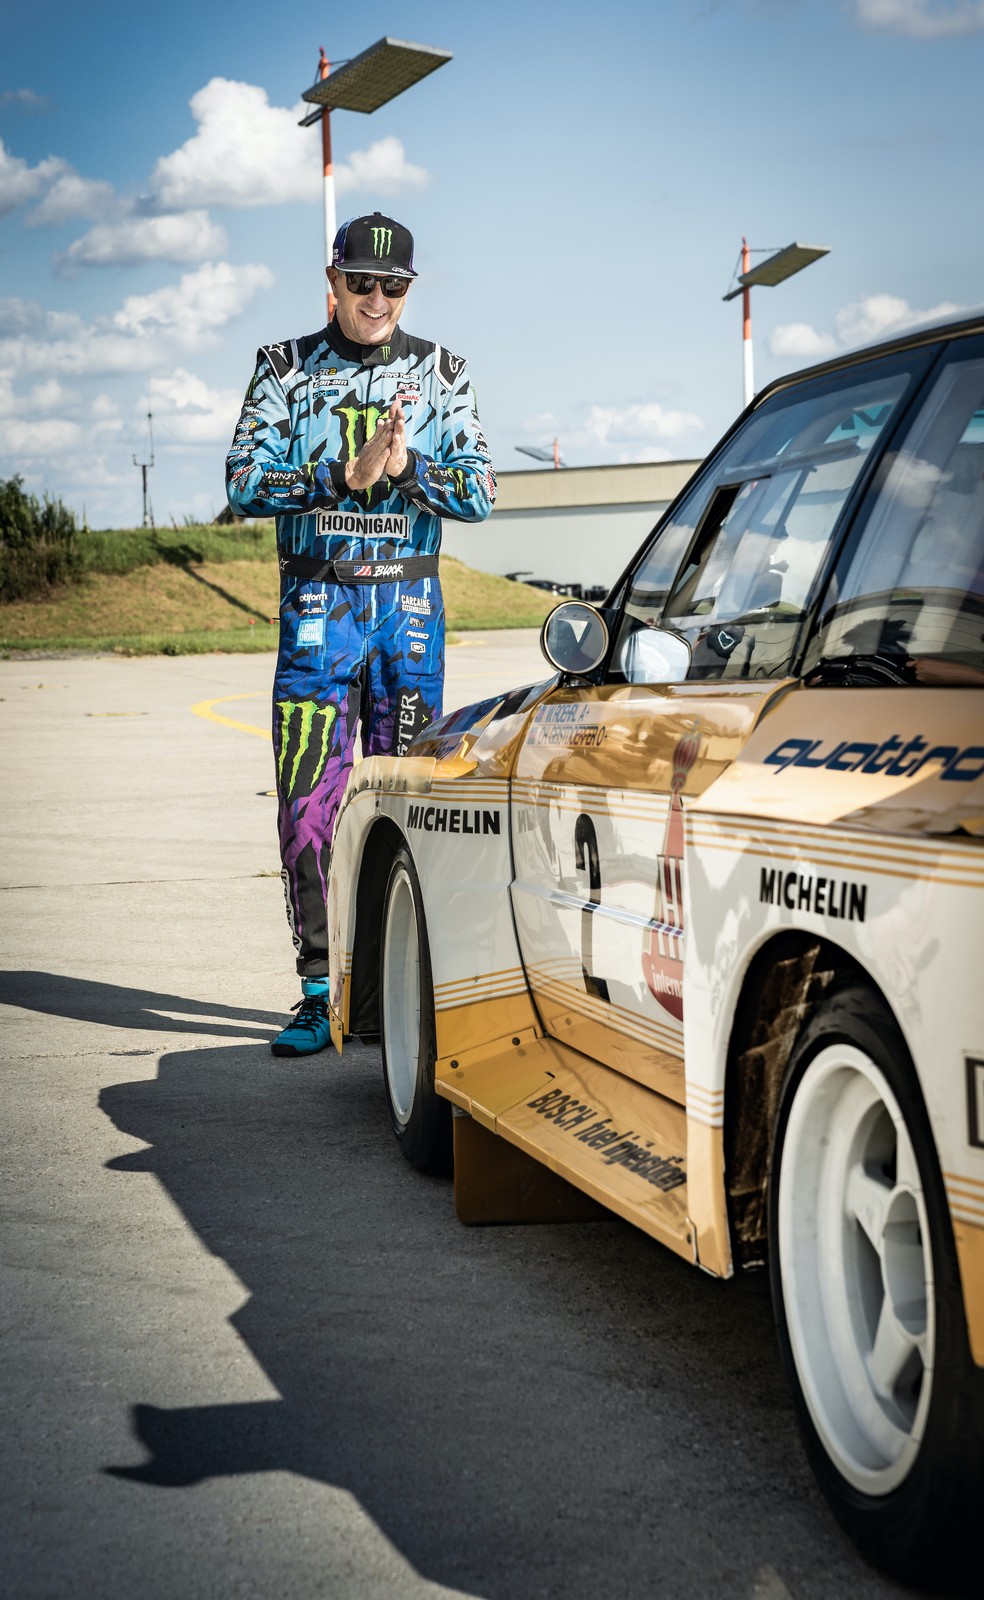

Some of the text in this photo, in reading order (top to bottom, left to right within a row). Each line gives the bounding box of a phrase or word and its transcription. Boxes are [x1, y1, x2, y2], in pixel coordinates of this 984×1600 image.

[313, 380, 348, 388] can-am
[373, 563, 404, 578] BLOCK
[300, 632, 320, 642] DRINK
[301, 623, 319, 633] LONG
[762, 734, 984, 782] quattro
[406, 804, 500, 835] MICHELIN
[759, 867, 868, 922] MICHELIN
[526, 1088, 598, 1131] BOSCH
[573, 1118, 634, 1151] fuel
